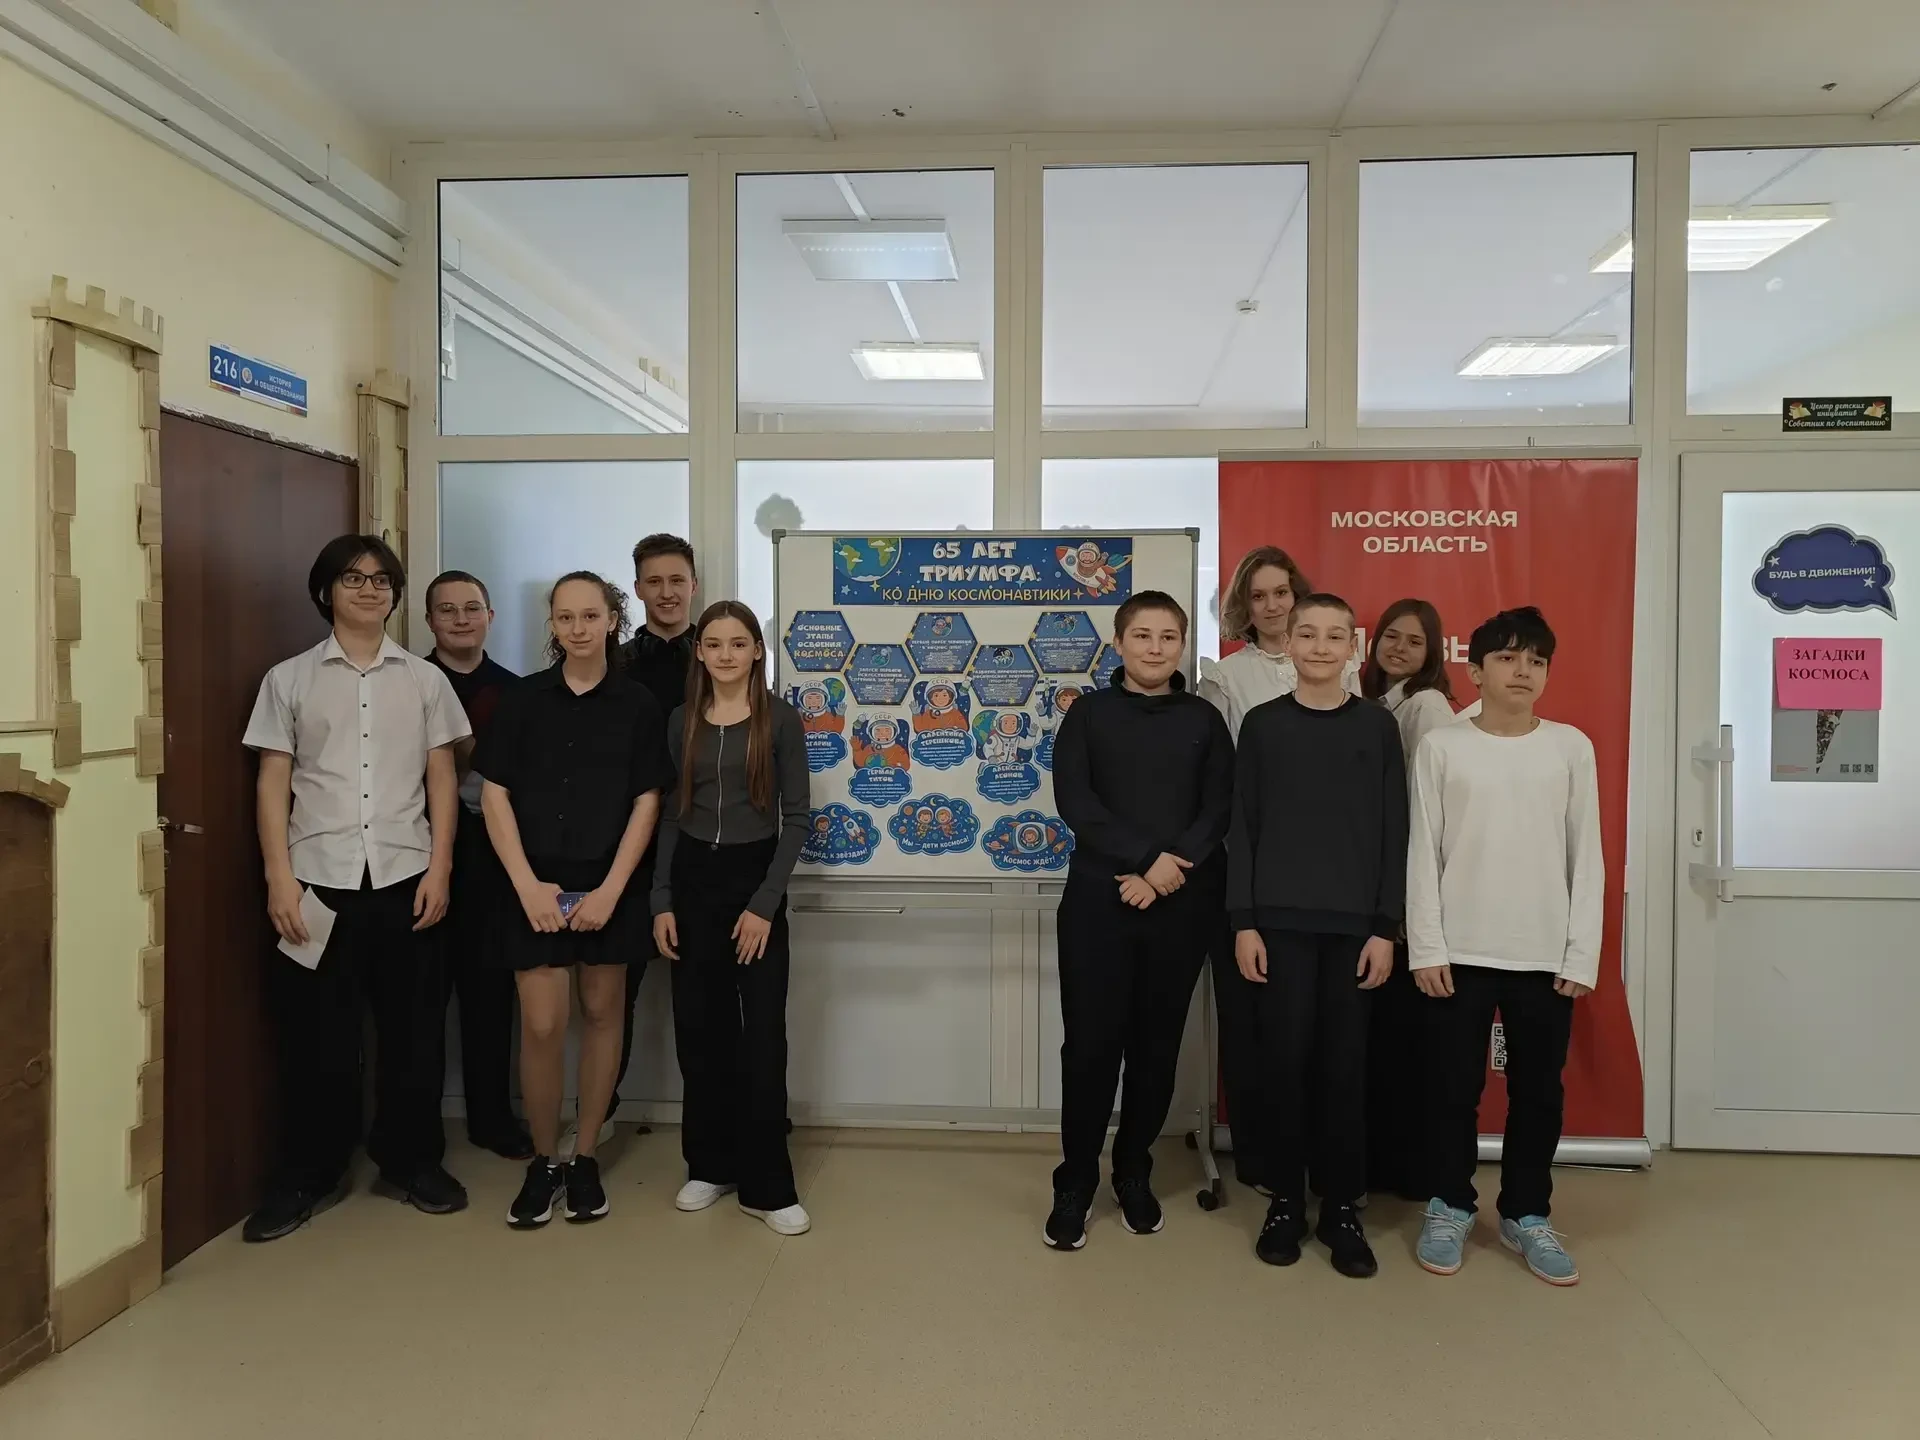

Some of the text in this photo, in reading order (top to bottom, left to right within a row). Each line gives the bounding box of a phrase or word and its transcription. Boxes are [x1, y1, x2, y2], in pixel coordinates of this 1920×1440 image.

[213, 356, 237, 379] 216
[269, 375, 291, 388] ИСТОРИЯ
[254, 379, 305, 402] И ОБЩЕСТВОЗНАНИЕ
[1810, 402, 1865, 411] Центр детских
[1836, 419, 1886, 427] воспитанию
[1331, 510, 1518, 528] МОСКОВСКАЯ
[932, 541, 1017, 559] 65 ЛЕТ
[1362, 536, 1488, 553] ОБЛАСТЬ
[1769, 567, 1876, 579] БУДЬ В ДВИЖЕНИИ!
[882, 588, 1071, 602] КО ДНЮ КОСМОНАВТИКИ
[797, 624, 842, 632] ОСНОВНЫЕ
[794, 650, 844, 658] КОСМОСА
[1792, 649, 1865, 662] ЗАГАДКИ
[1788, 668, 1870, 680] КОСМОСА
[901, 837, 914, 847] Мы
[940, 835, 970, 848] космоса!
[836, 847, 868, 859] звёздам!
[1003, 854, 1056, 865] Космос ждёт!
